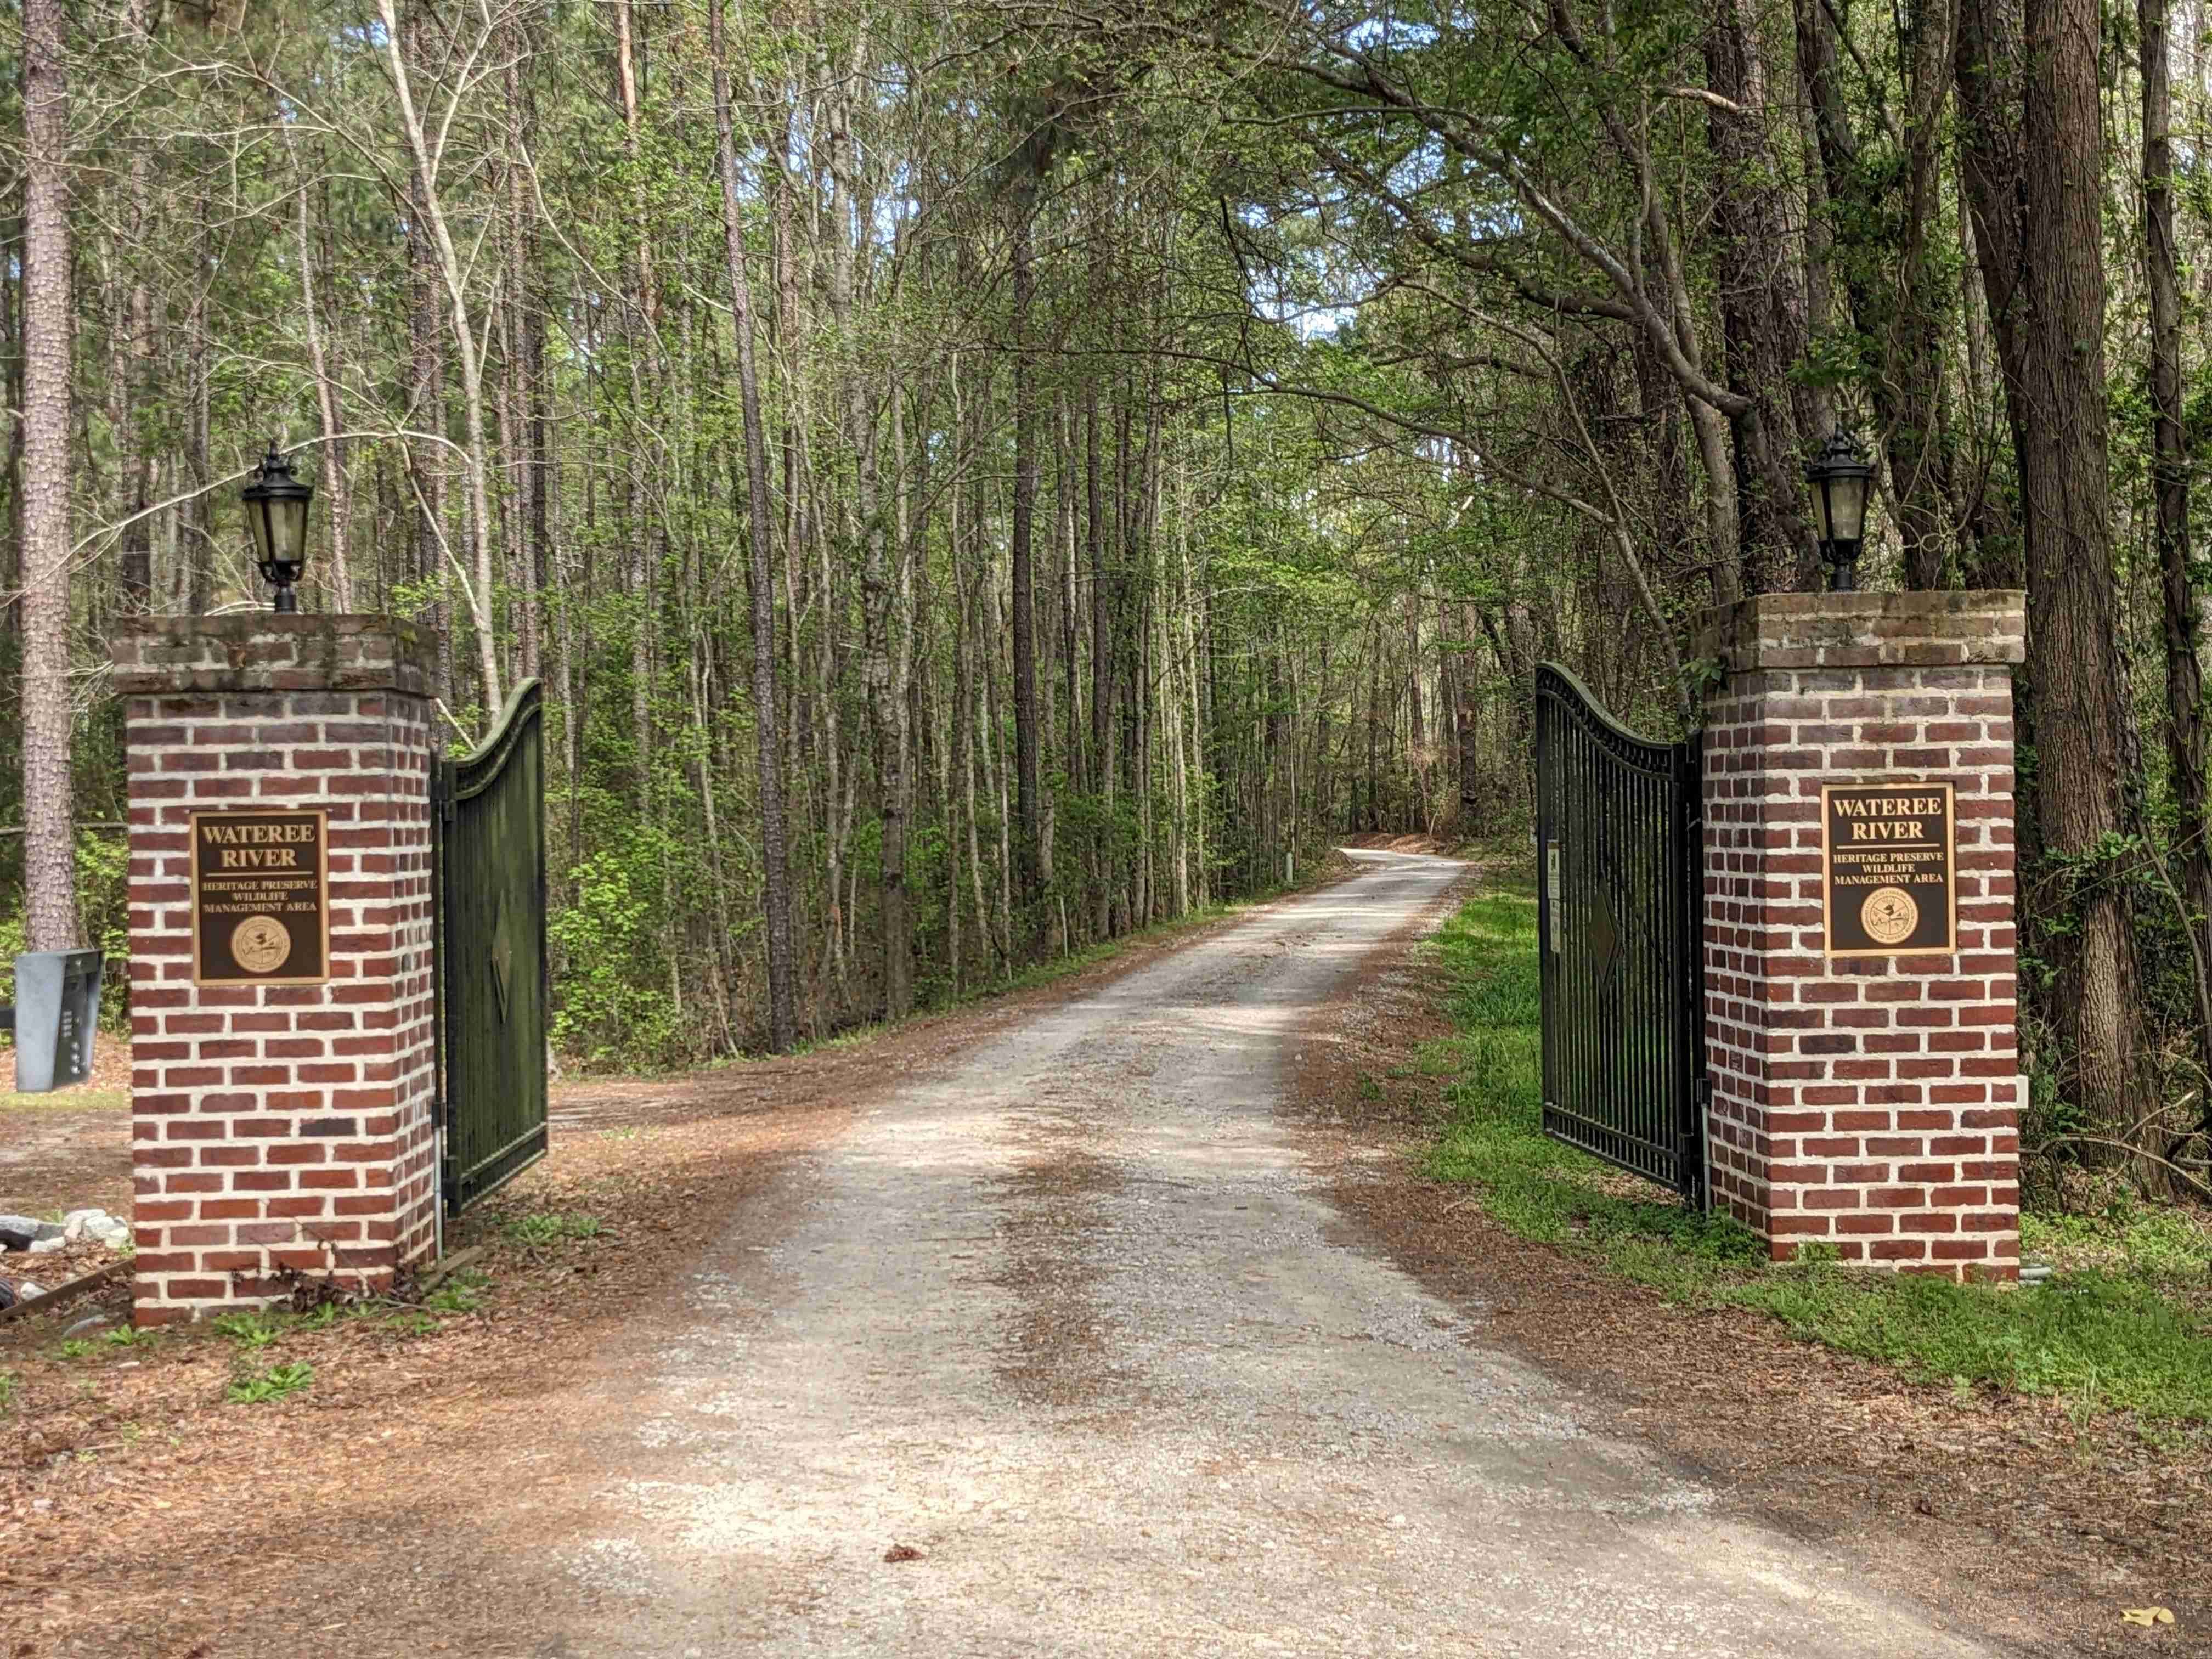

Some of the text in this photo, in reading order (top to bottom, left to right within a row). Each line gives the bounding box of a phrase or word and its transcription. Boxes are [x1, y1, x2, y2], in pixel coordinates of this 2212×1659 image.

[1833, 797, 1942, 817] WATEREE
[202, 825, 315, 843] WATEREE
[1852, 821, 1924, 840] RIVER
[222, 849, 297, 867] RIVER
[1833, 852, 1944, 863] HERITAGE PRESERVE
[1863, 864, 1916, 873] WILDLIFE
[202, 879, 317, 891] HERITAGE PRESERVE
[1834, 873, 1943, 885] MANAGEMENT AREA
[232, 891, 289, 901] WILDLIFE
[202, 902, 317, 913] MANAGEMENT AREA
